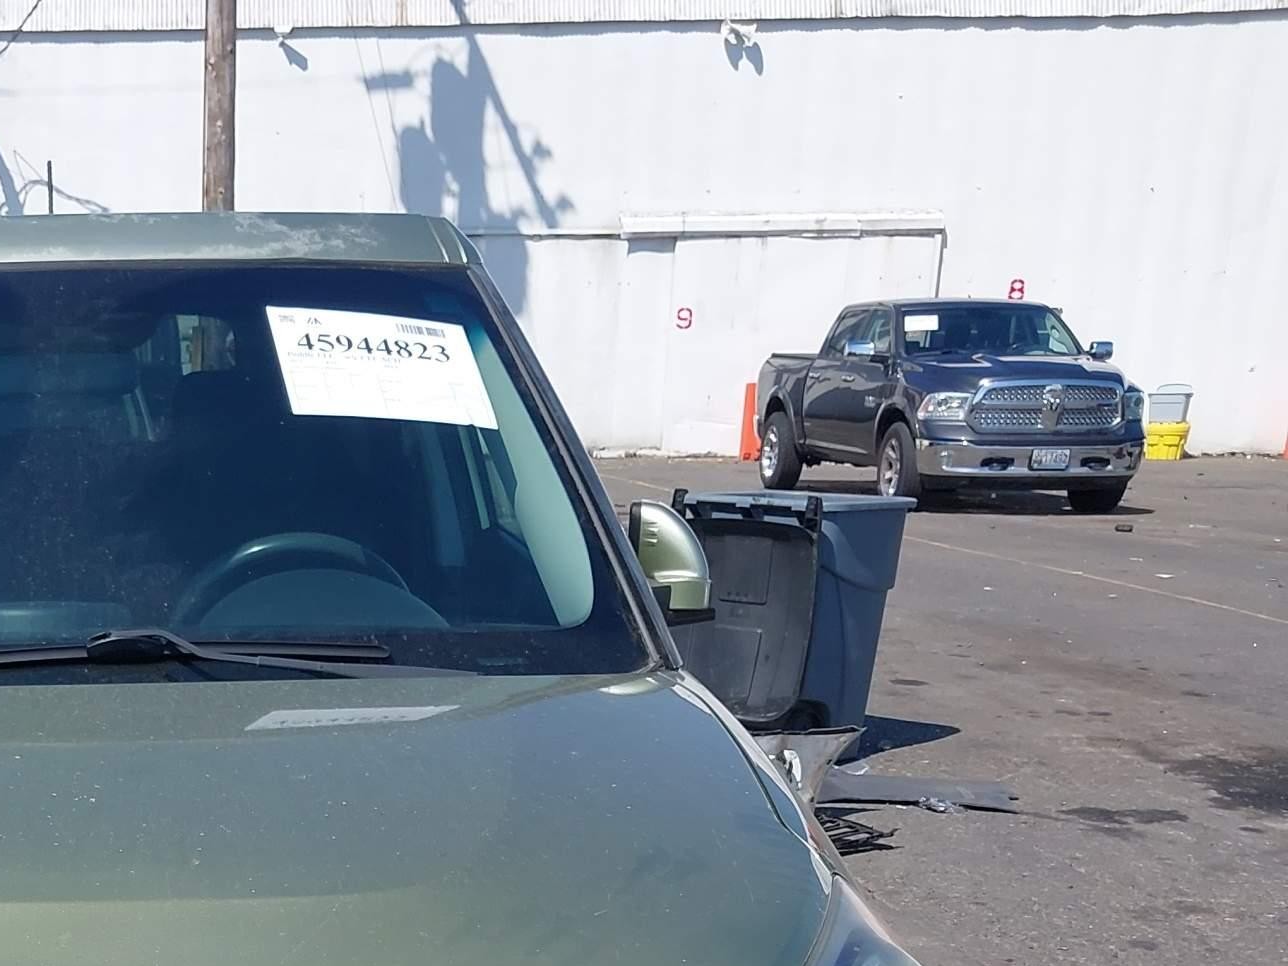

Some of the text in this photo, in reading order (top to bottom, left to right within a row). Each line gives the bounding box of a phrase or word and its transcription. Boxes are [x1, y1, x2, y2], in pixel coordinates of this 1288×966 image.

[1008, 279, 1025, 300] 8
[676, 307, 693, 329] 9
[297, 332, 451, 363] 45944823
